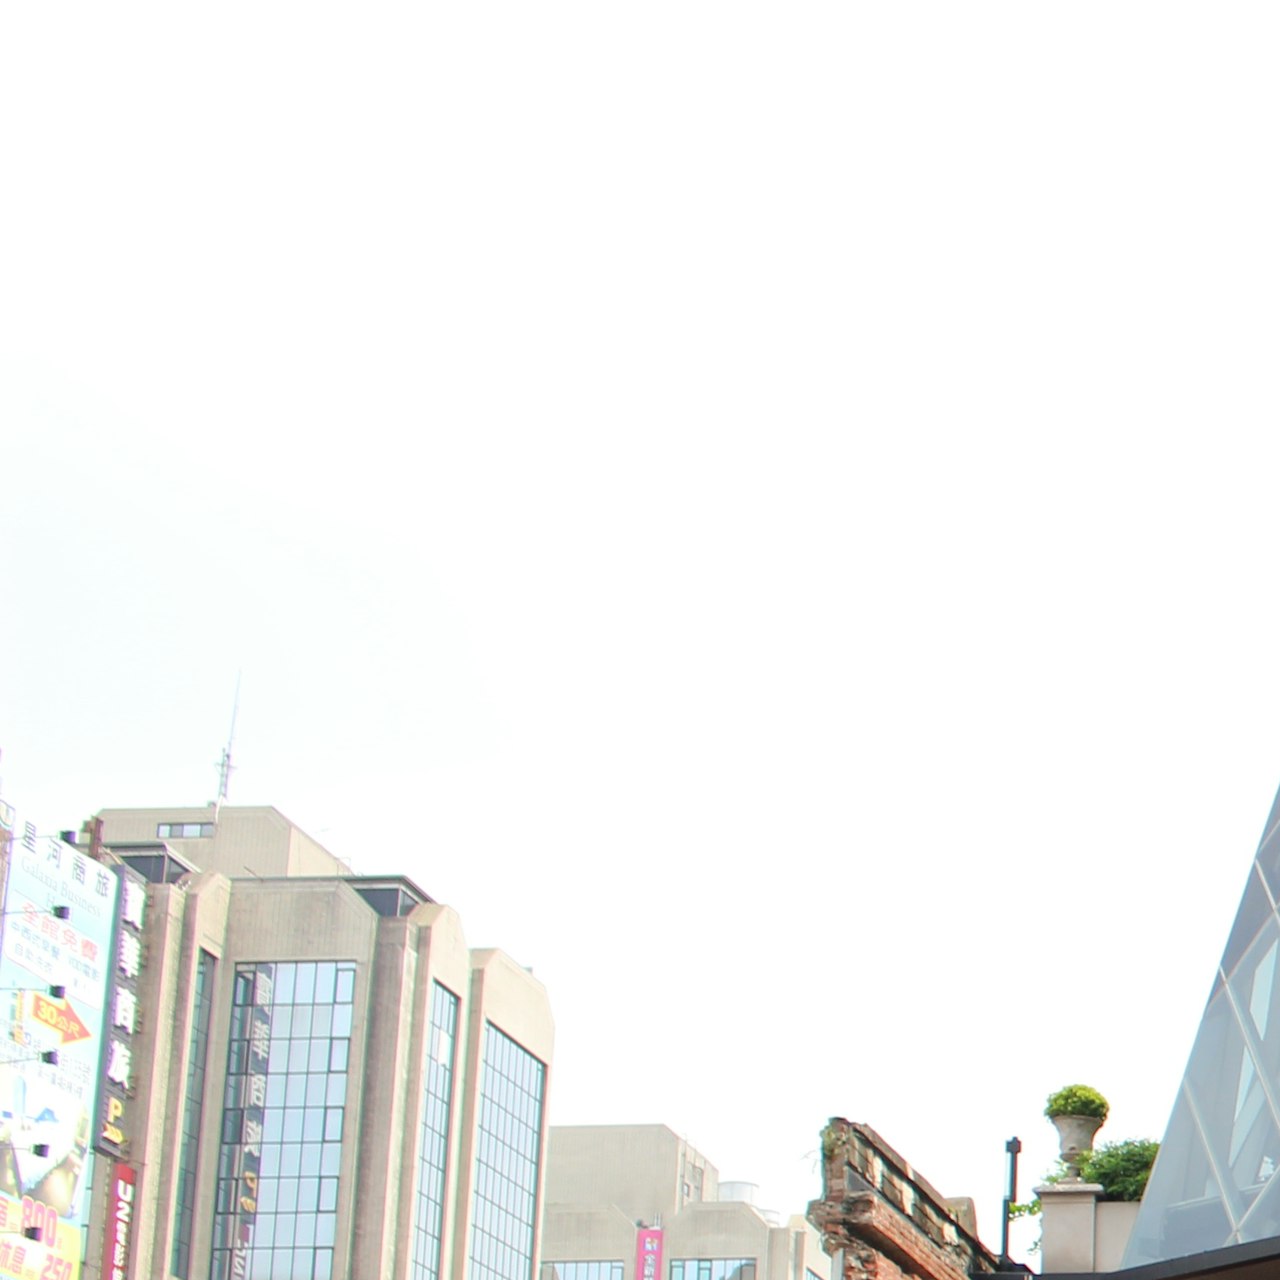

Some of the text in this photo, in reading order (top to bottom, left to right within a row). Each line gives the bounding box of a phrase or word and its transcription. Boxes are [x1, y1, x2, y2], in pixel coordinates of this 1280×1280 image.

[21, 820, 111, 898] 星河商旅
[36, 1000, 81, 1040] 30公尺
[108, 1096, 124, 1123] P
[22, 1194, 59, 1249] 800
